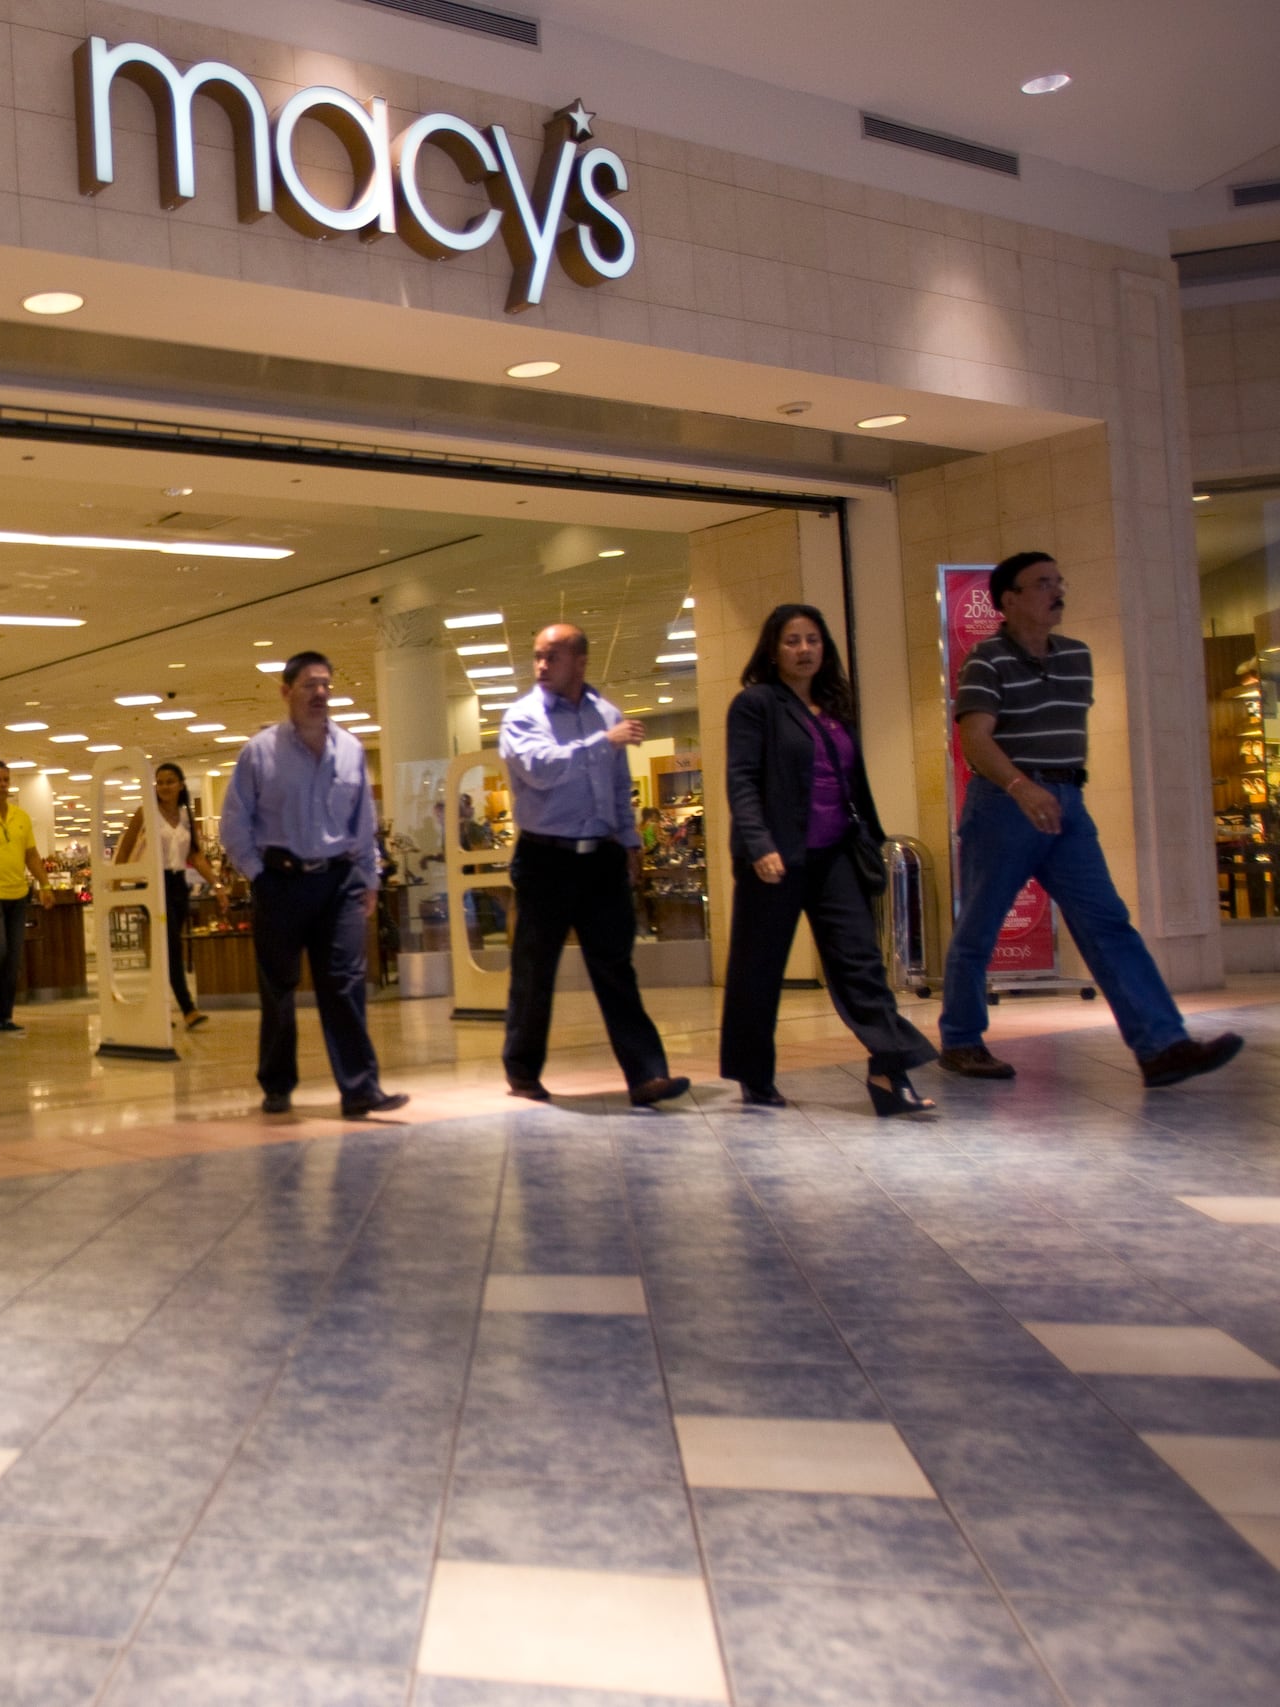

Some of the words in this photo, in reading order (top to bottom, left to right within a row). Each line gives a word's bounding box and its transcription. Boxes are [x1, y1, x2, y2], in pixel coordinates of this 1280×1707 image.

[74, 34, 636, 312] macy's
[972, 589, 991, 604] EX
[964, 603, 997, 619] 20%
